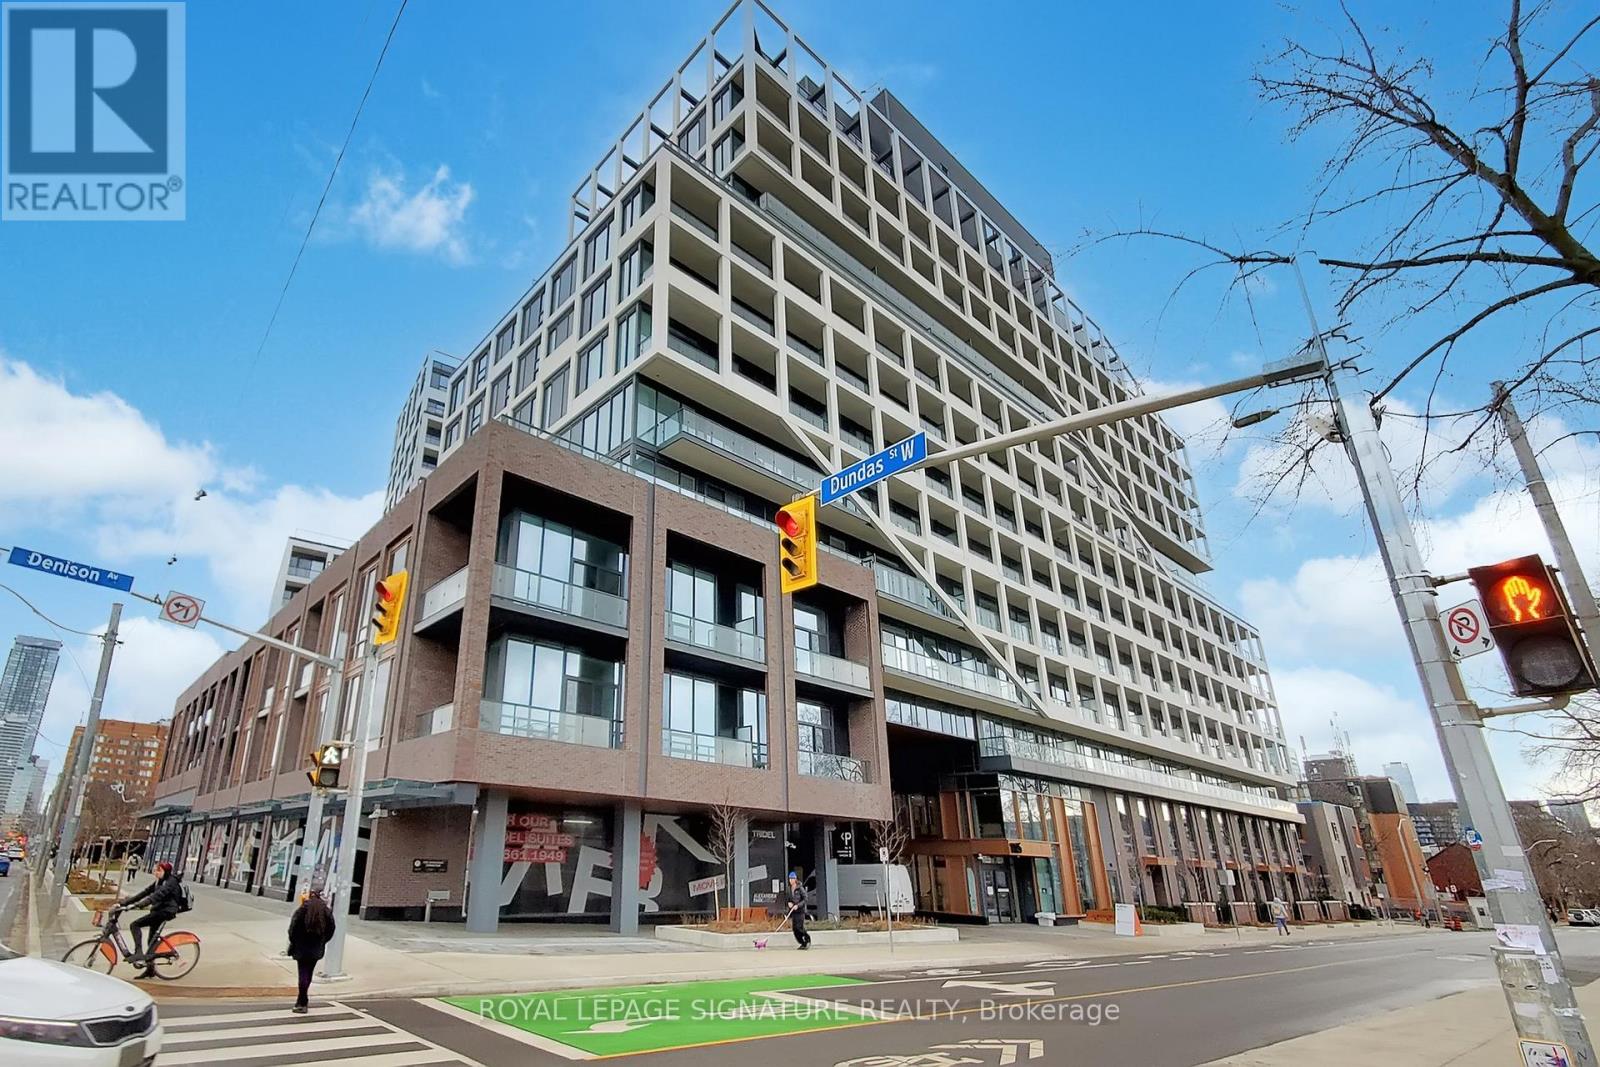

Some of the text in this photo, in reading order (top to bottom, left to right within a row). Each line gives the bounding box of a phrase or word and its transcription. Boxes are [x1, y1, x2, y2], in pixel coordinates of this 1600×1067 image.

[830, 439, 915, 495] Dundas St W
[28, 552, 119, 582] Denison Av
[519, 816, 549, 827] OUR
[528, 833, 573, 845] SUITES
